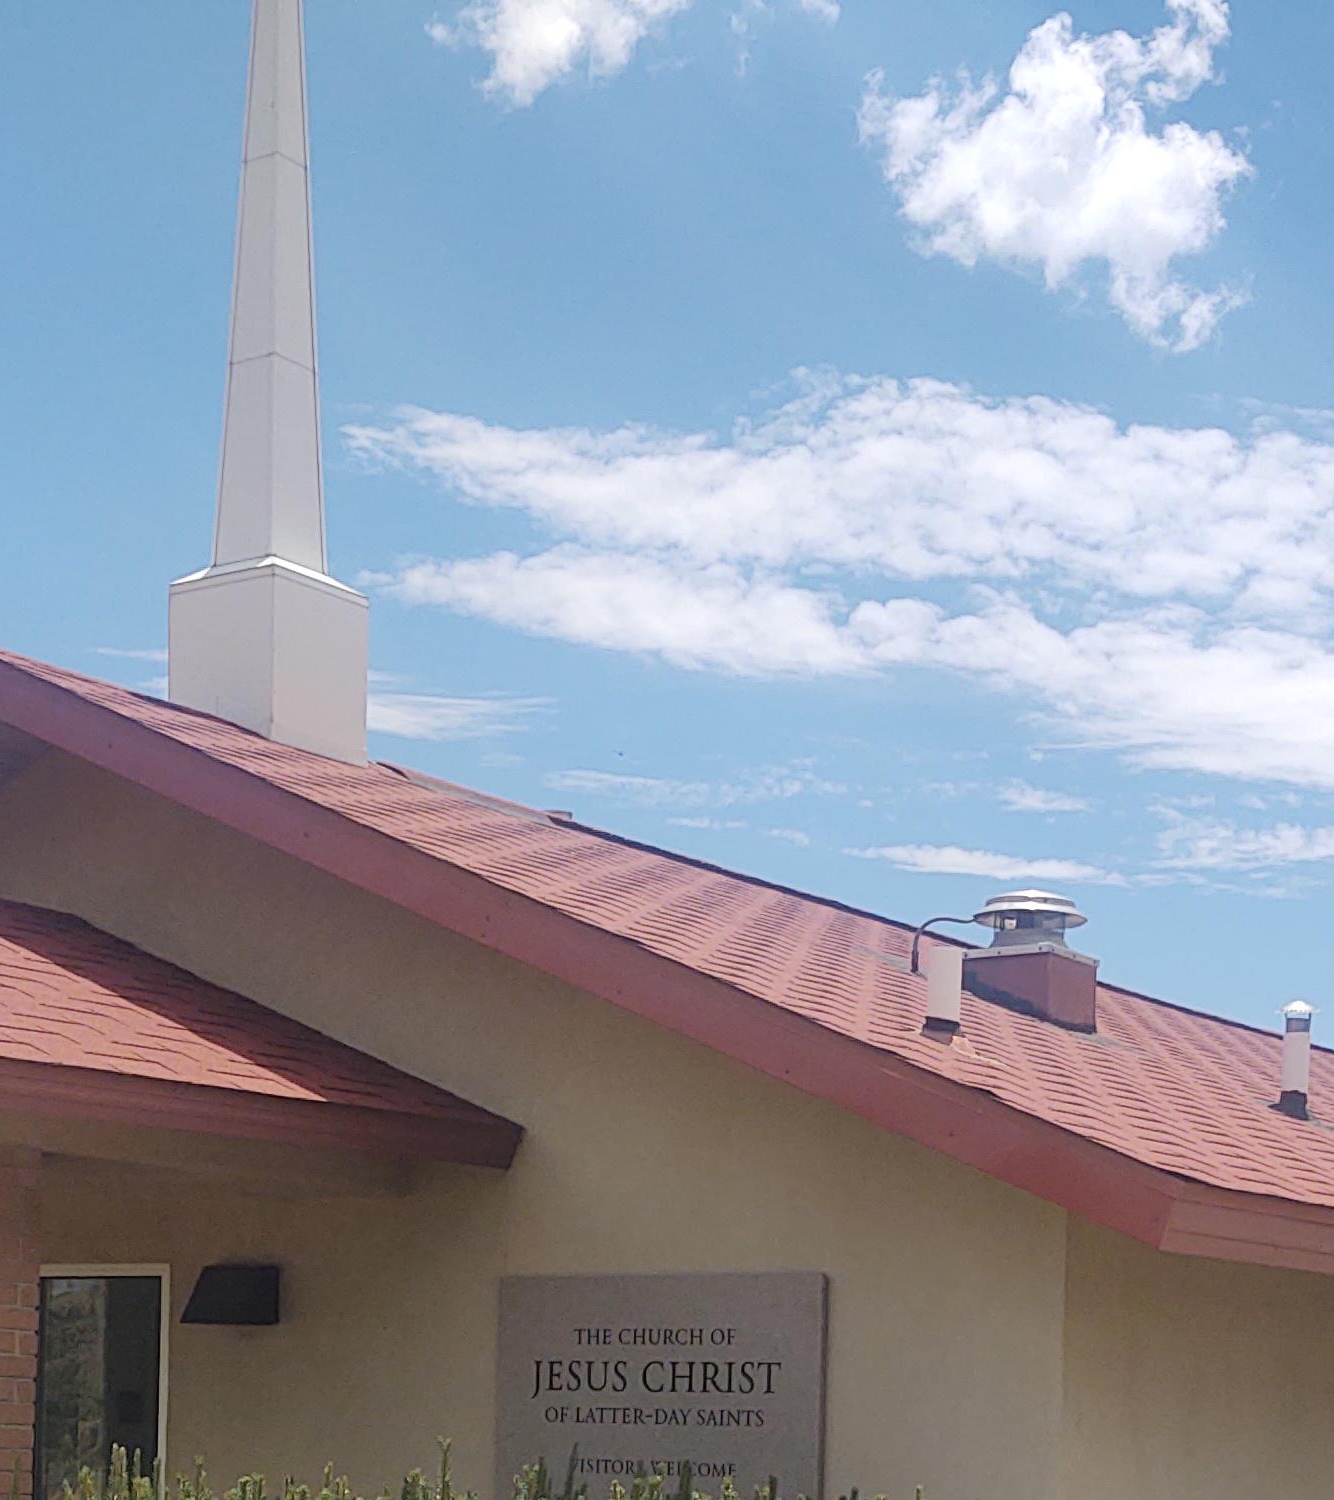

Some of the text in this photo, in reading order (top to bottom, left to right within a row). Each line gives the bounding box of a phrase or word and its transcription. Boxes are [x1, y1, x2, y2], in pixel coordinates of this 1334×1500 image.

[573, 1328, 737, 1346] THE CHURCH OF
[531, 1360, 782, 1399] JESUS CHRIST
[545, 1406, 765, 1427] OF LATTER-DAY SAINTS
[570, 1458, 645, 1476] VISITOR
